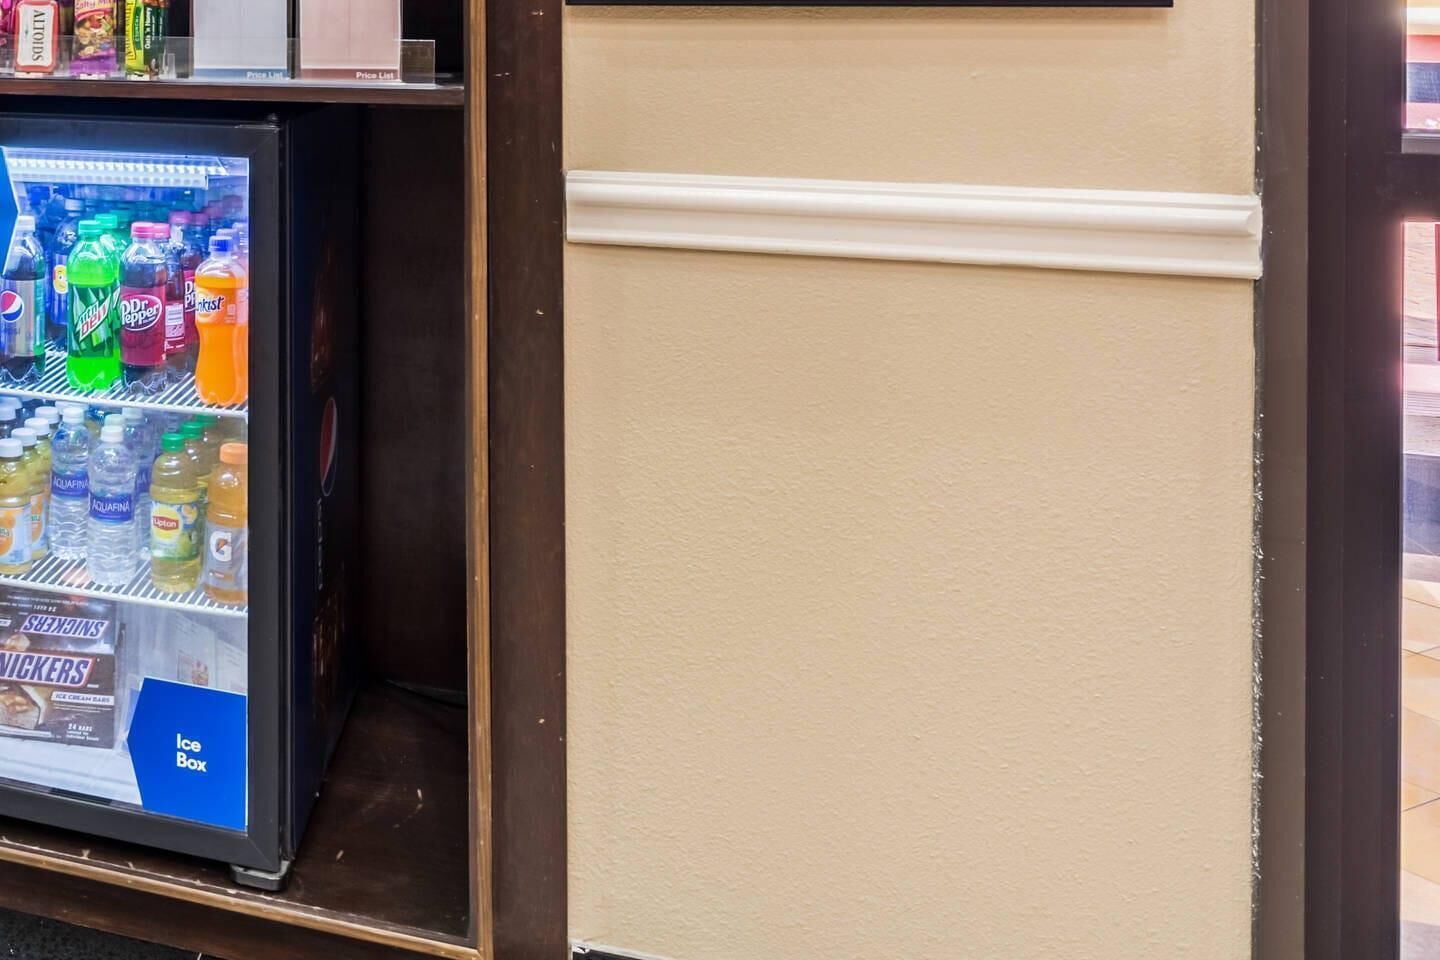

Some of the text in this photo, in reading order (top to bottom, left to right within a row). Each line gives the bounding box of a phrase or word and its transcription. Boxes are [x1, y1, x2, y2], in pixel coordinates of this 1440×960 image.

[32, 9, 46, 61] ALTOIDS
[246, 71, 283, 79] Price List
[355, 71, 394, 80] Price List
[121, 301, 160, 327] Pepper
[129, 298, 148, 315] Dr
[53, 477, 89, 490] AQUAFINA
[91, 499, 131, 513] AQUAFINA
[153, 519, 177, 529] Lipton
[209, 531, 232, 562] G
[22, 615, 105, 639] SNICKERS
[176, 733, 202, 752] Ice
[176, 751, 207, 772] Box
